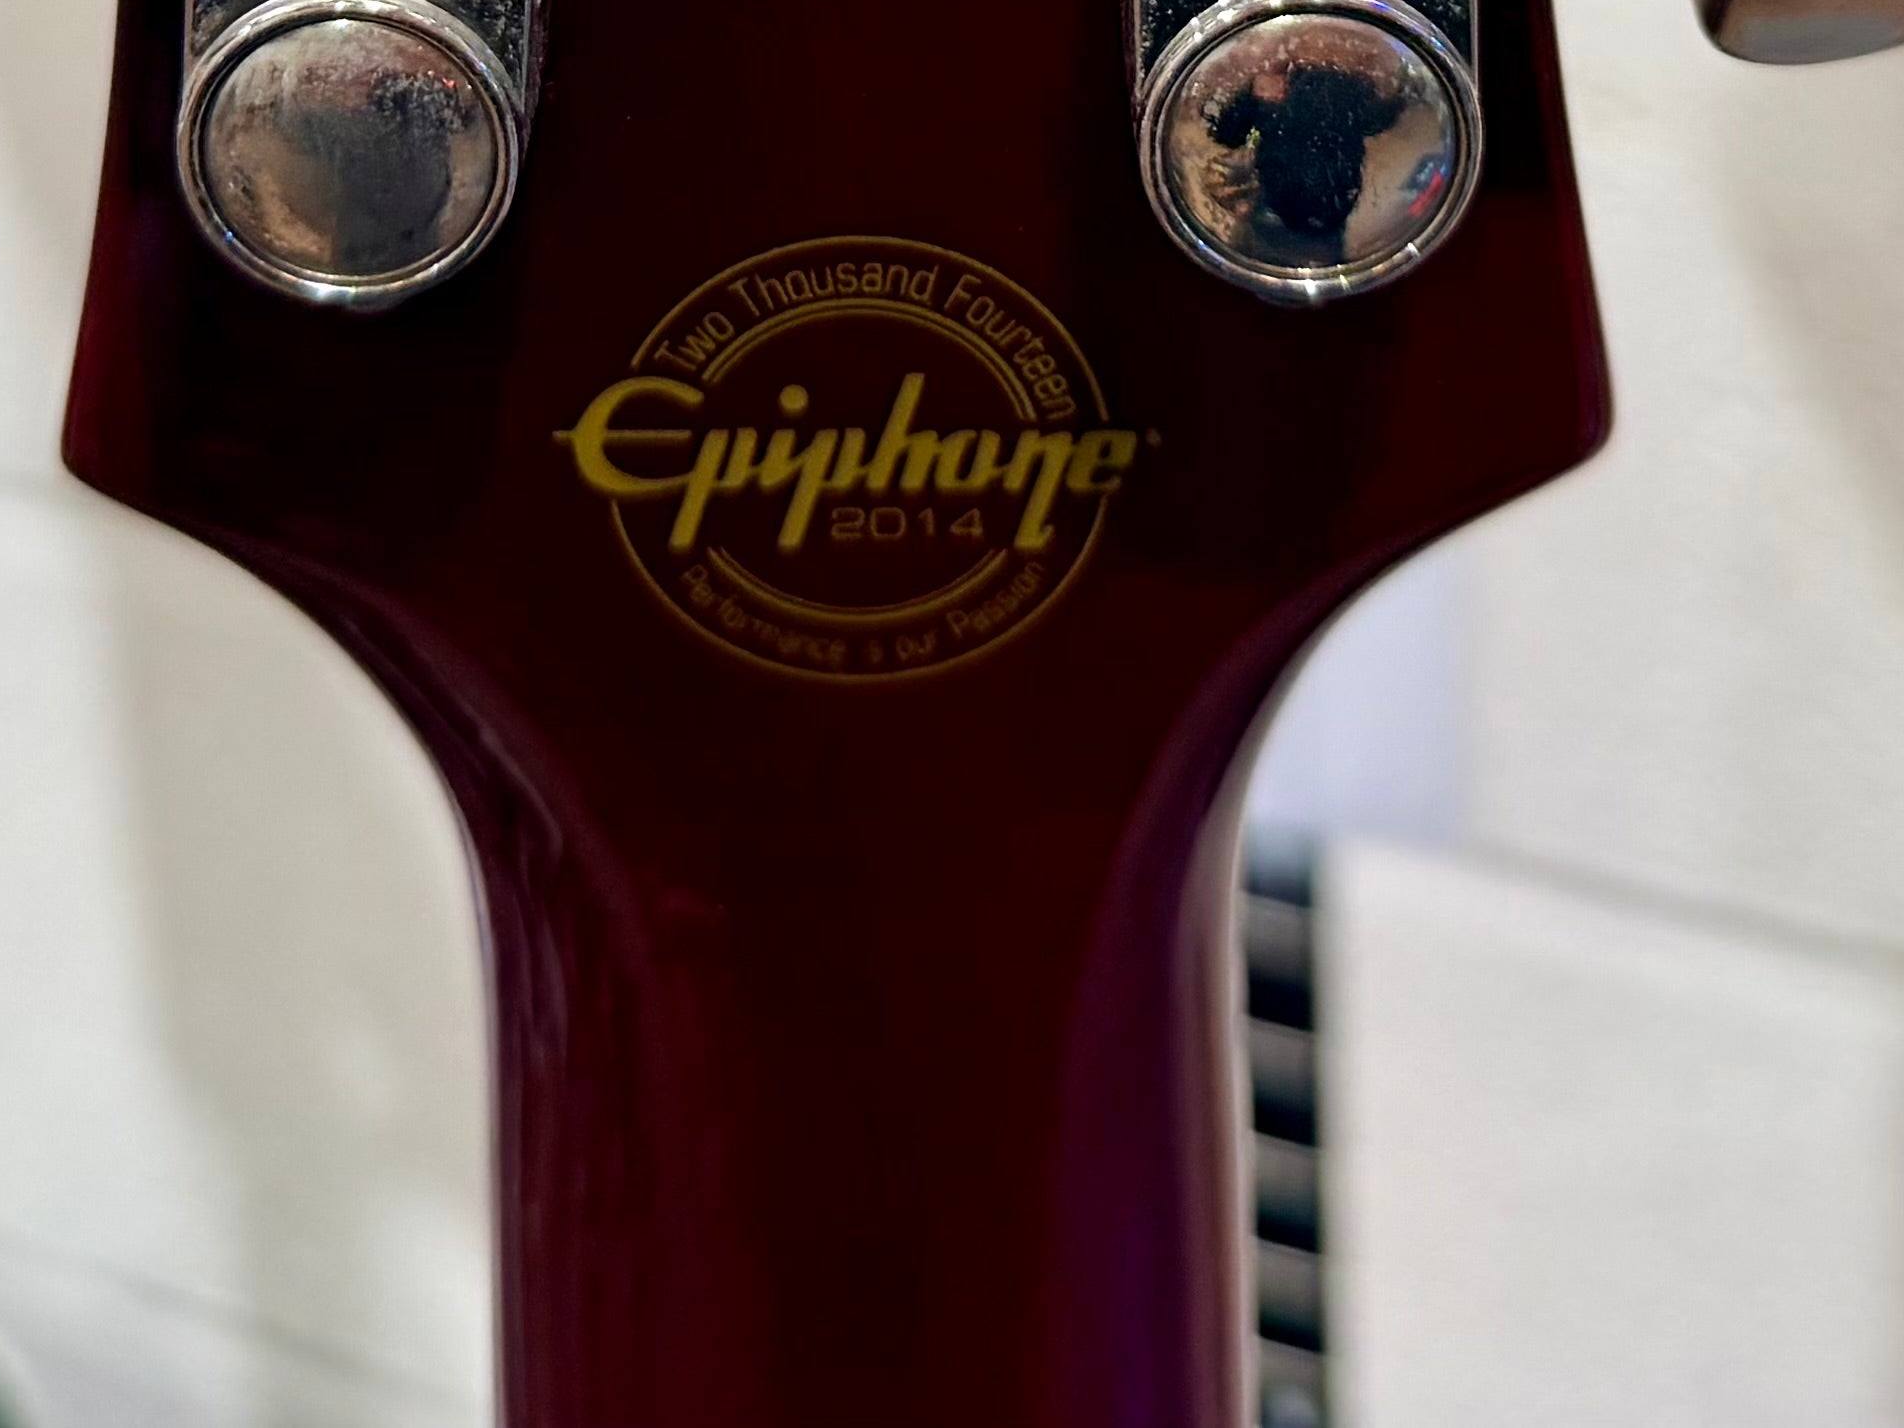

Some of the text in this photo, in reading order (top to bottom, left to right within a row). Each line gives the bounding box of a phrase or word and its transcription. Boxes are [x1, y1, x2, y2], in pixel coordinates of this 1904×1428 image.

[653, 261, 1077, 422] Two Thousand Fourteen
[552, 372, 1138, 553] Epiphone
[830, 506, 984, 541] 2014
